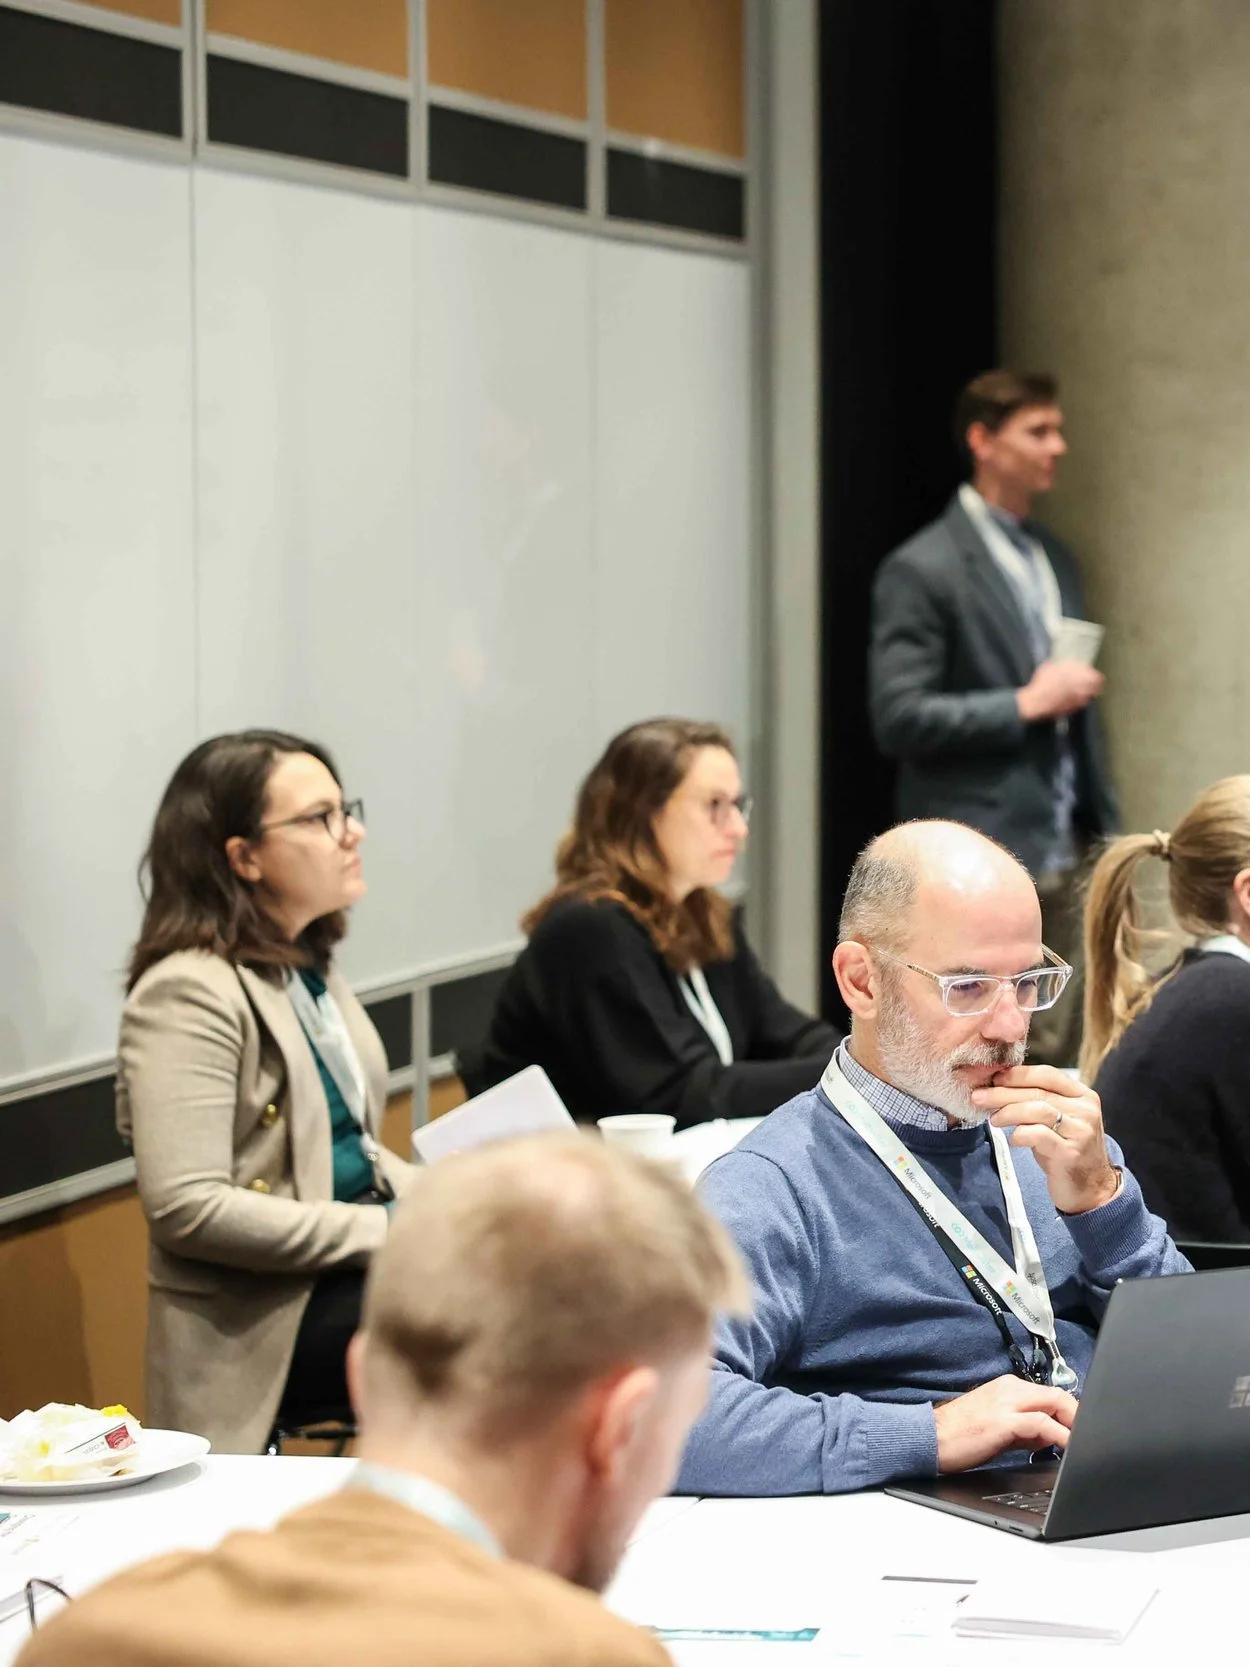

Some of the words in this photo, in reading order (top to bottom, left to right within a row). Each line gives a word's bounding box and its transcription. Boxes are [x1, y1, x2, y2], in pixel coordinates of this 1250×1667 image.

[904, 1168, 932, 1199] Microsoft
[973, 1278, 1002, 1315] Microsoft
[1012, 1293, 1040, 1325] Microsoft
